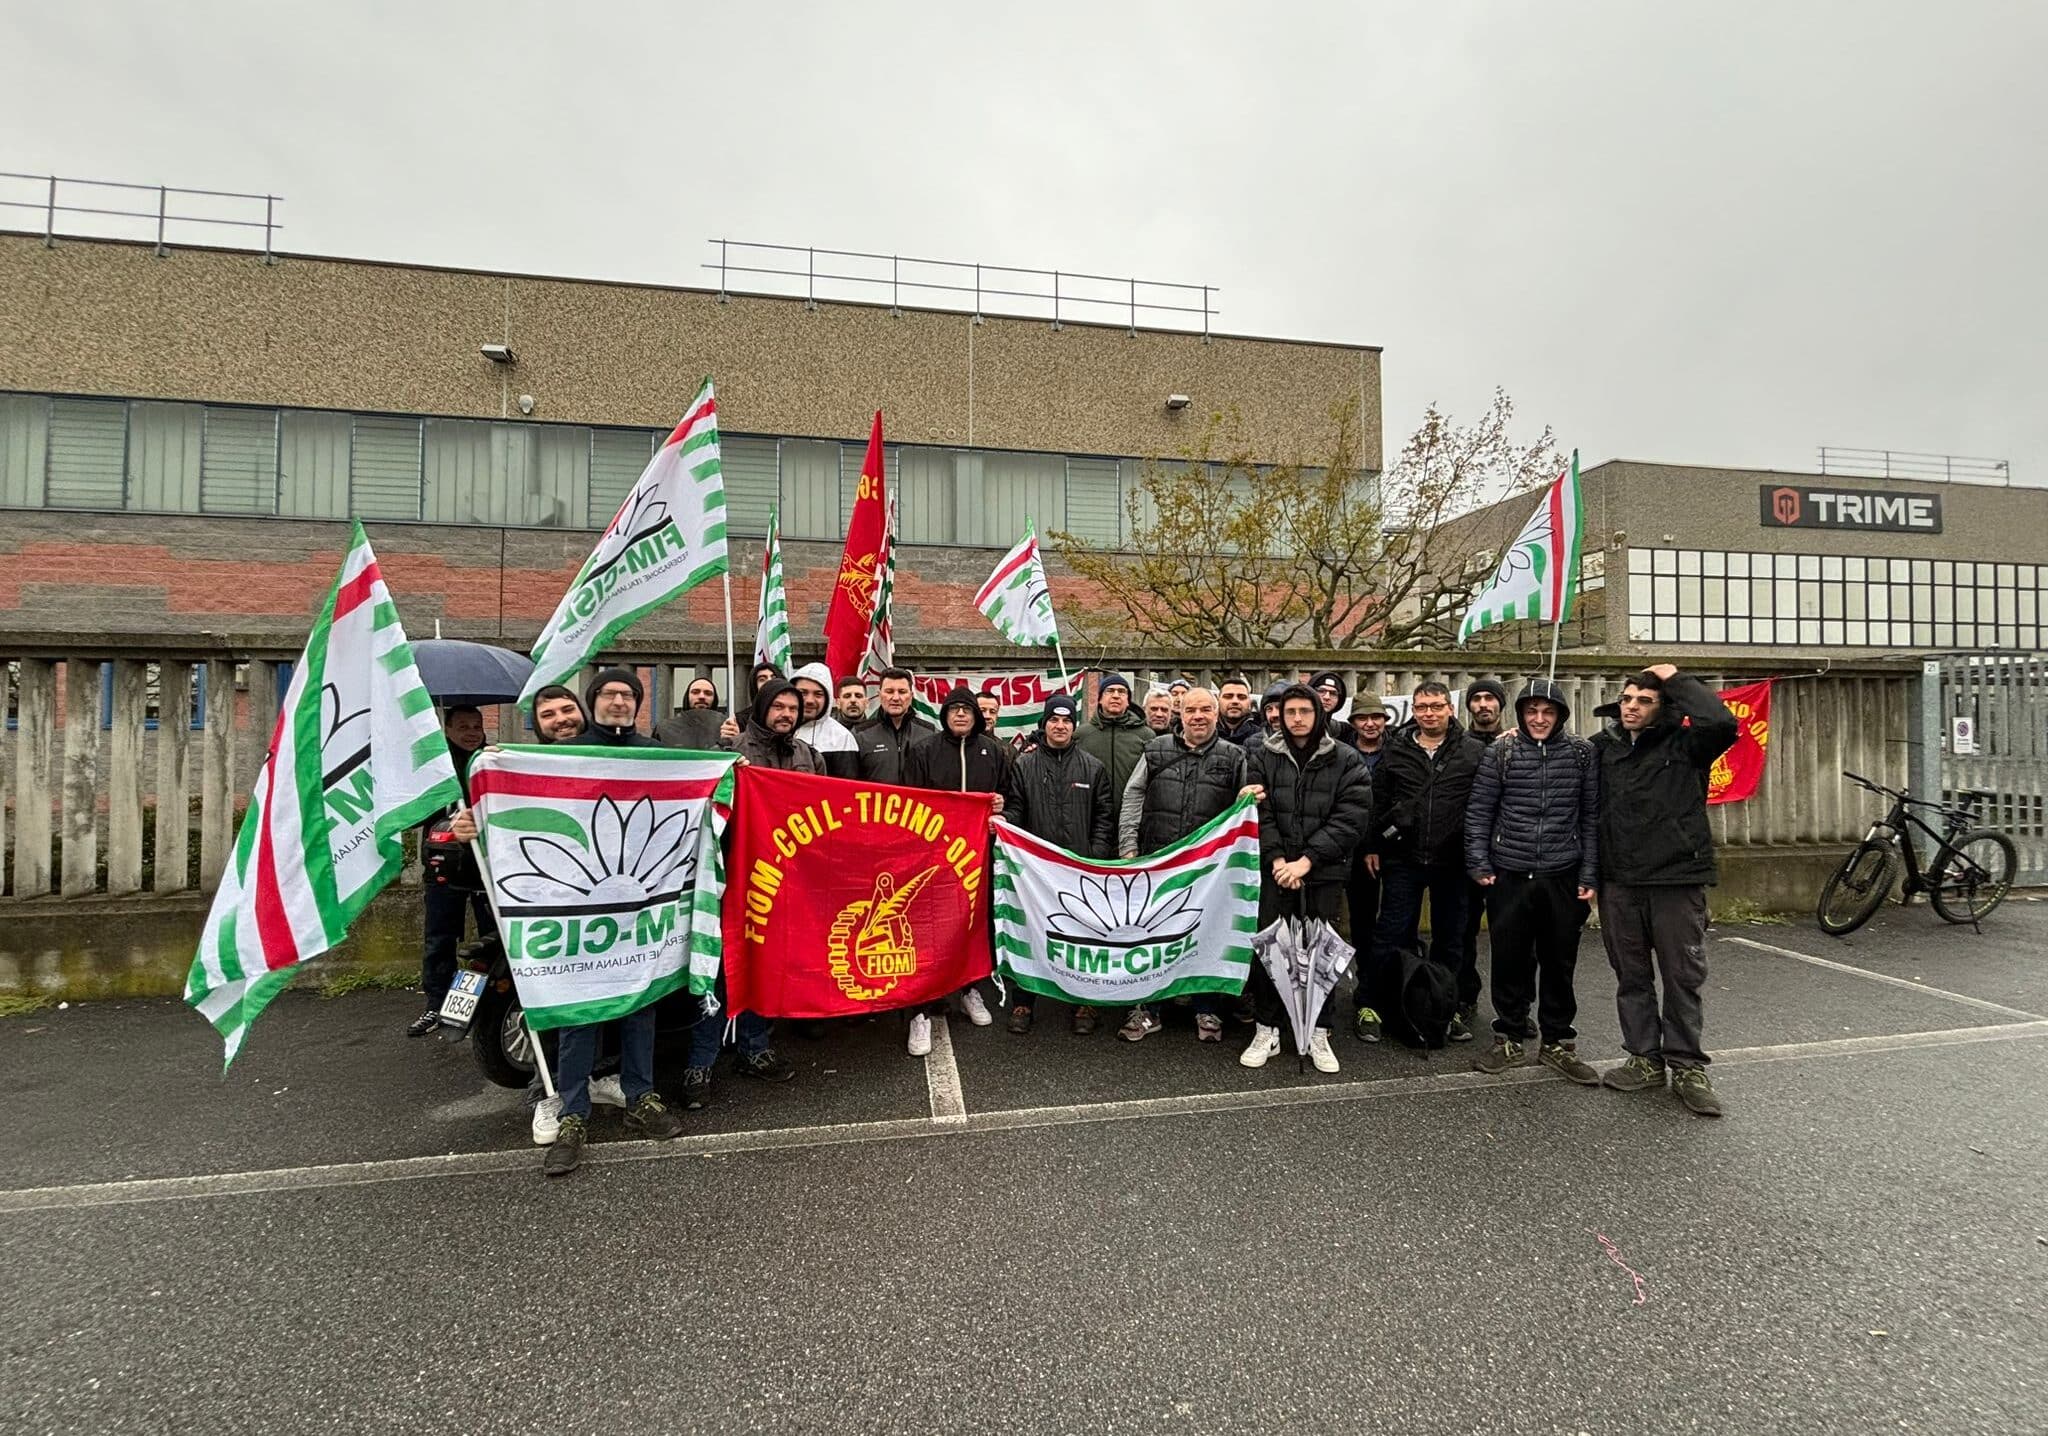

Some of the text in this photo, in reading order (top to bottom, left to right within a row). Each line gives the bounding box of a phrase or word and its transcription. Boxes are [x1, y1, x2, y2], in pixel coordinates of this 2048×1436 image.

[1808, 493, 1934, 527] TRIME
[981, 675, 1053, 706] CISL
[867, 953, 910, 975] FIOM
[1046, 933, 1198, 975] FIM-CISL
[458, 973, 475, 992] EZ
[444, 994, 475, 1017] 18348
